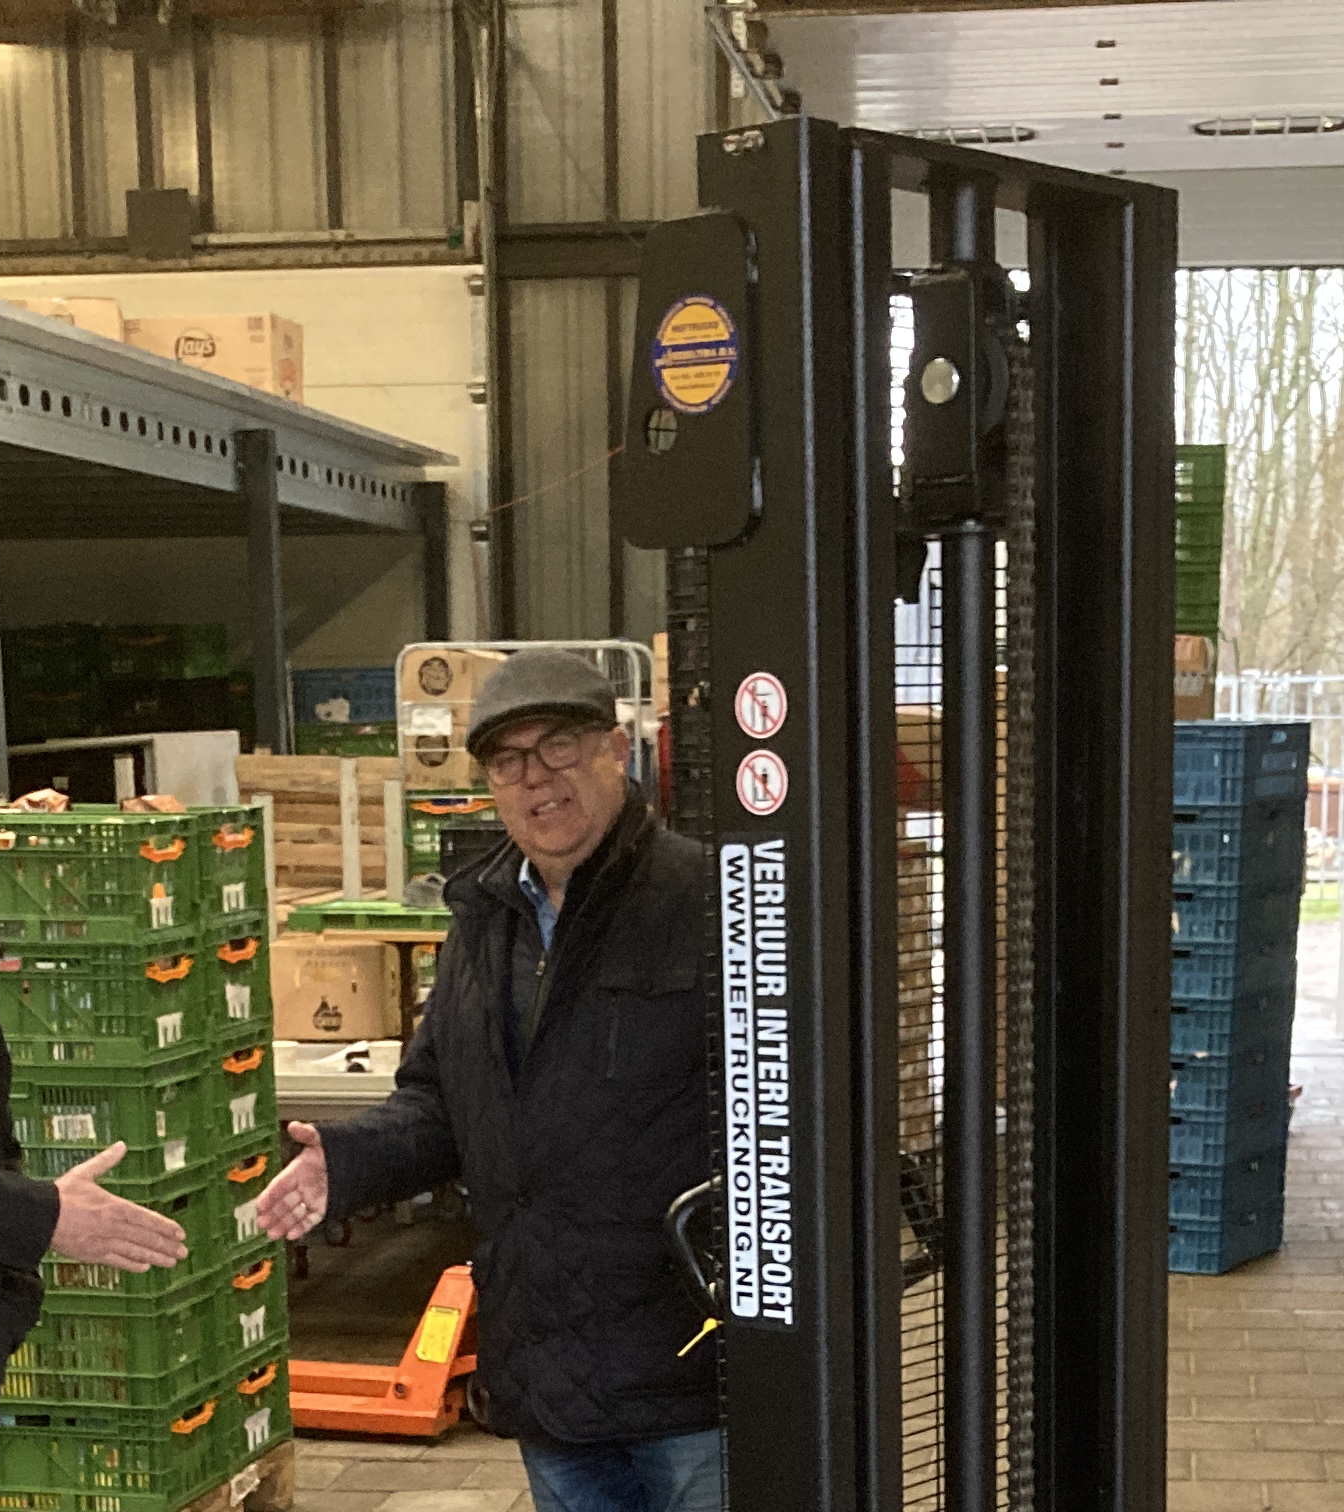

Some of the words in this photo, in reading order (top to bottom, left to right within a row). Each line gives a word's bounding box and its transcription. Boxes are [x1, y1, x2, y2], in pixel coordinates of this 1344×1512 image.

[753, 839, 787, 997] VERHUUR
[726, 854, 754, 1307] WWW.HEFTRUCKNODIG.NL
[757, 1008, 790, 1127] INTERN
[759, 1135, 793, 1325] TRANSPORT
